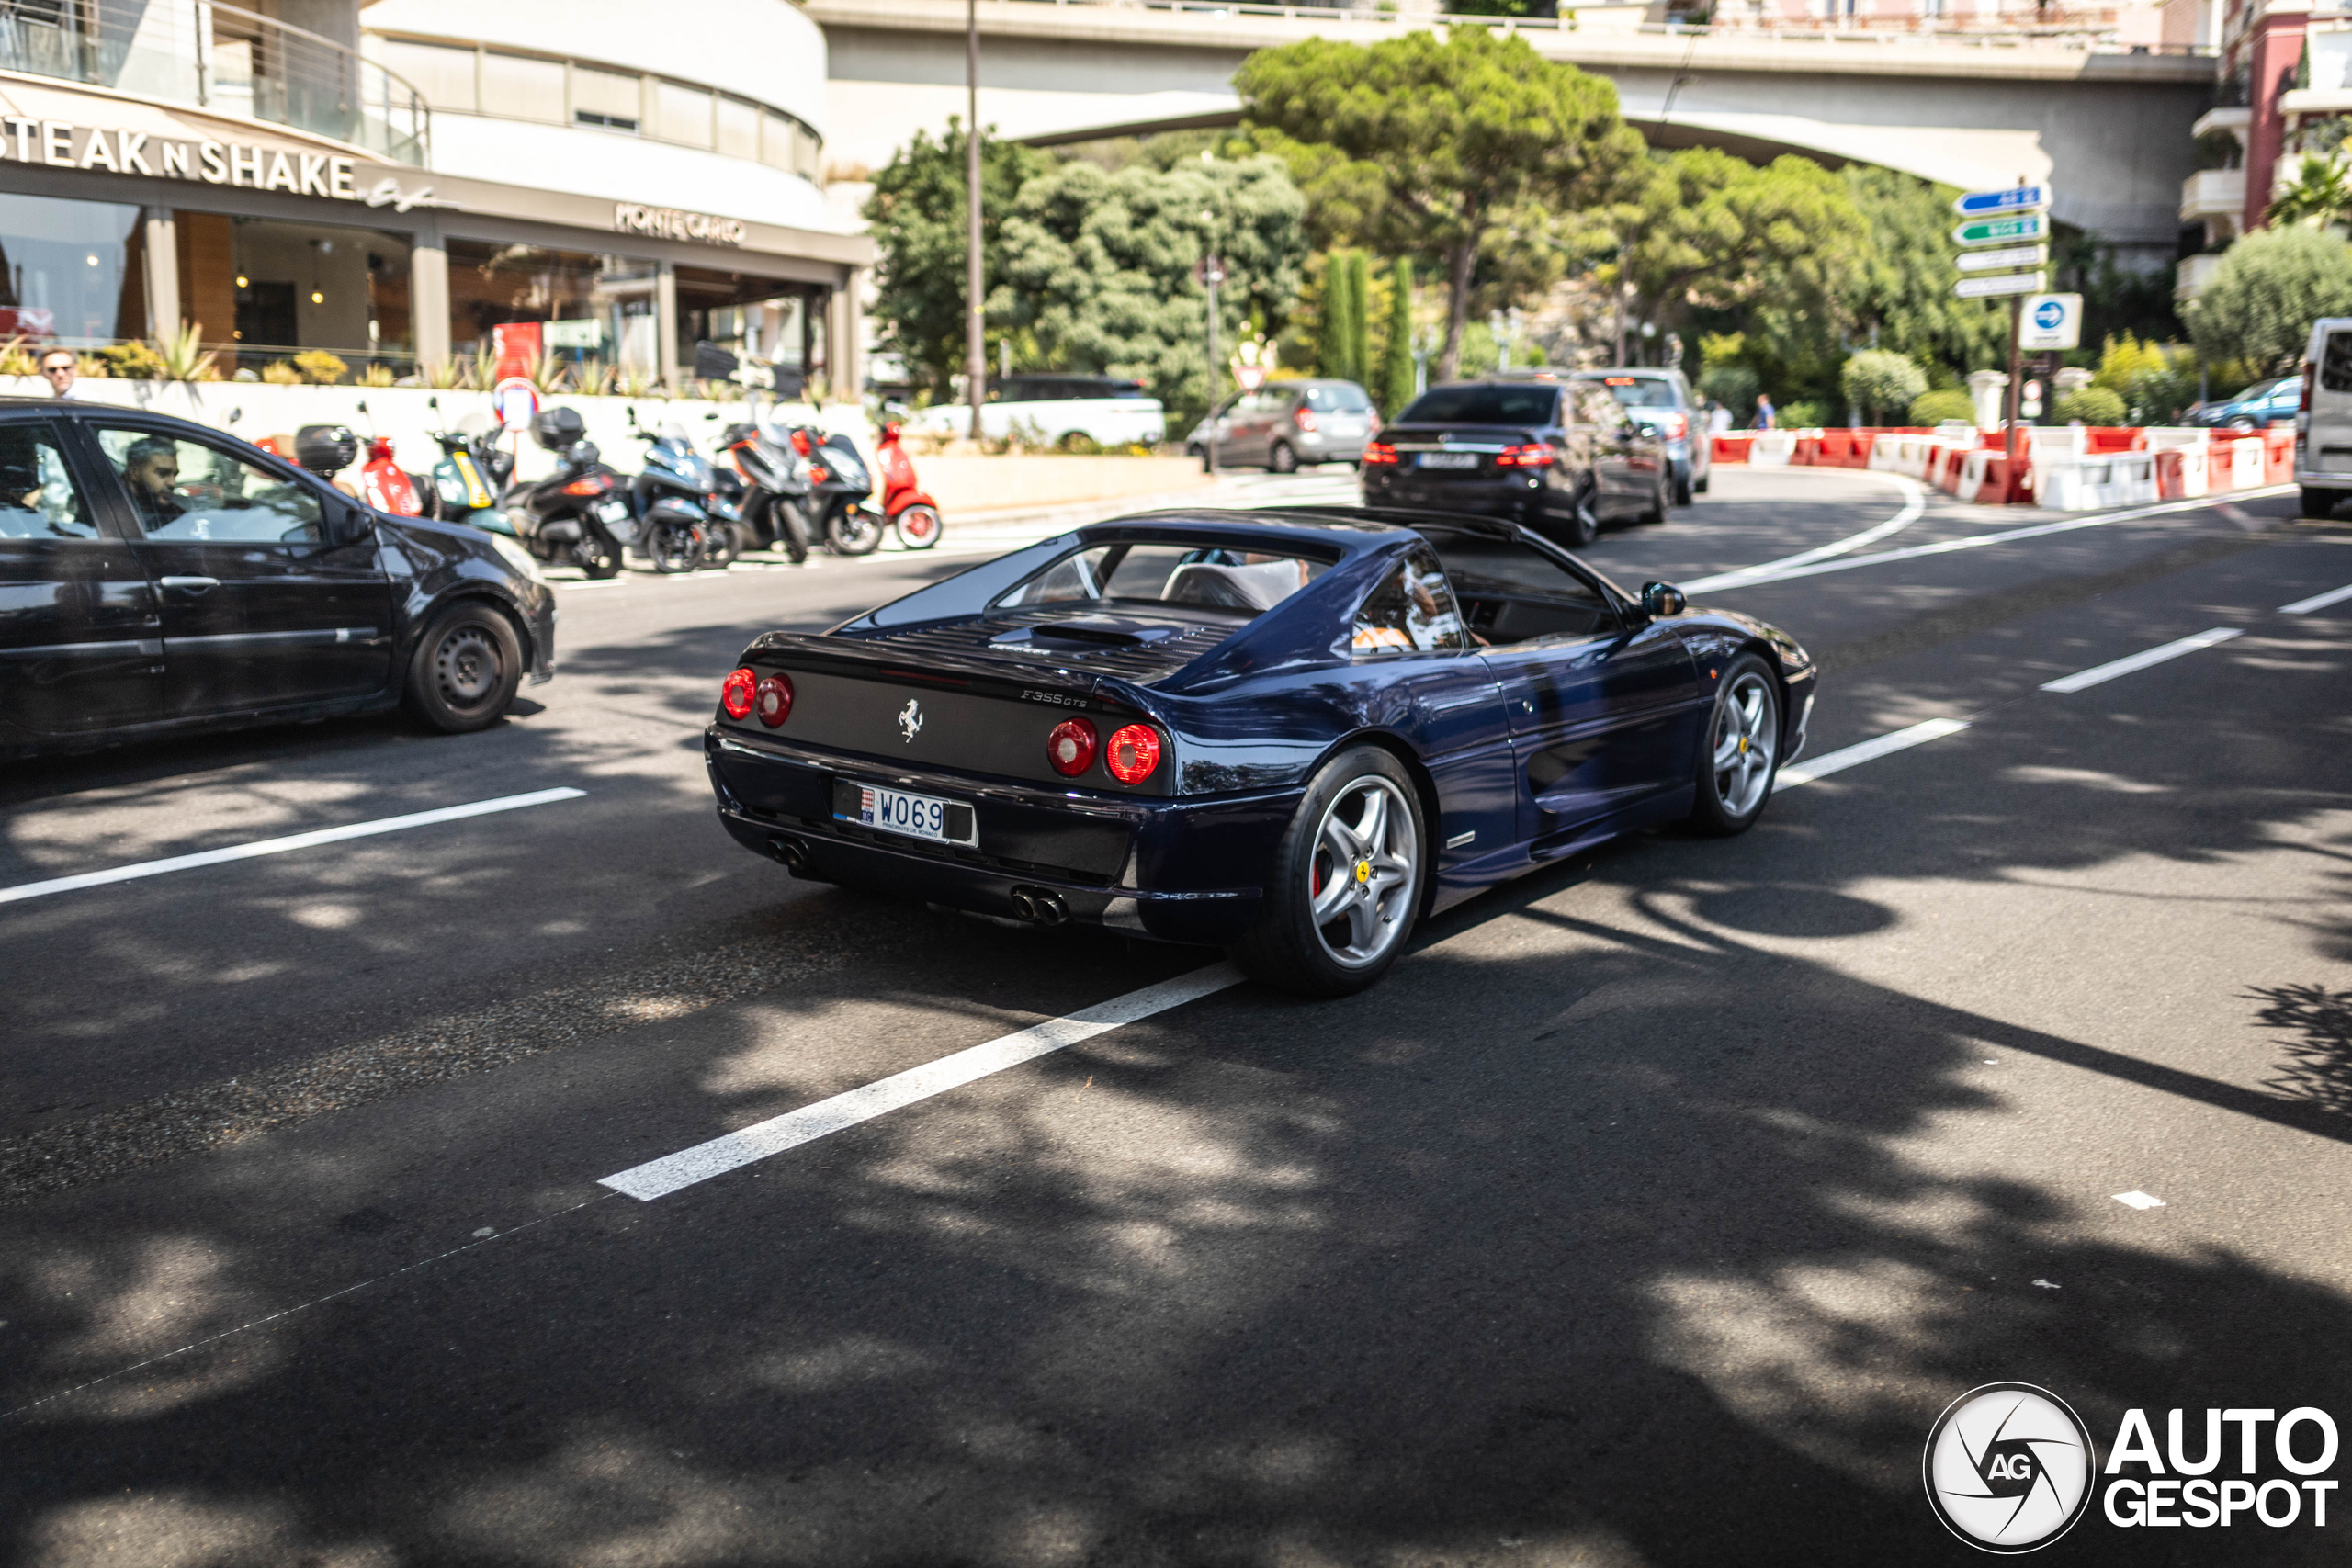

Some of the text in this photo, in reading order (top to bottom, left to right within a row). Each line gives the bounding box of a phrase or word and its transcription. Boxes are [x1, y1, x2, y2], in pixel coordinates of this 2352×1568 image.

[0, 115, 356, 200] TEAK N SHAKE
[615, 202, 745, 246] MONTE CARLO
[1020, 689, 1087, 708] F355 GTS
[862, 811, 873, 823] MC
[918, 829, 938, 838] MONACO
